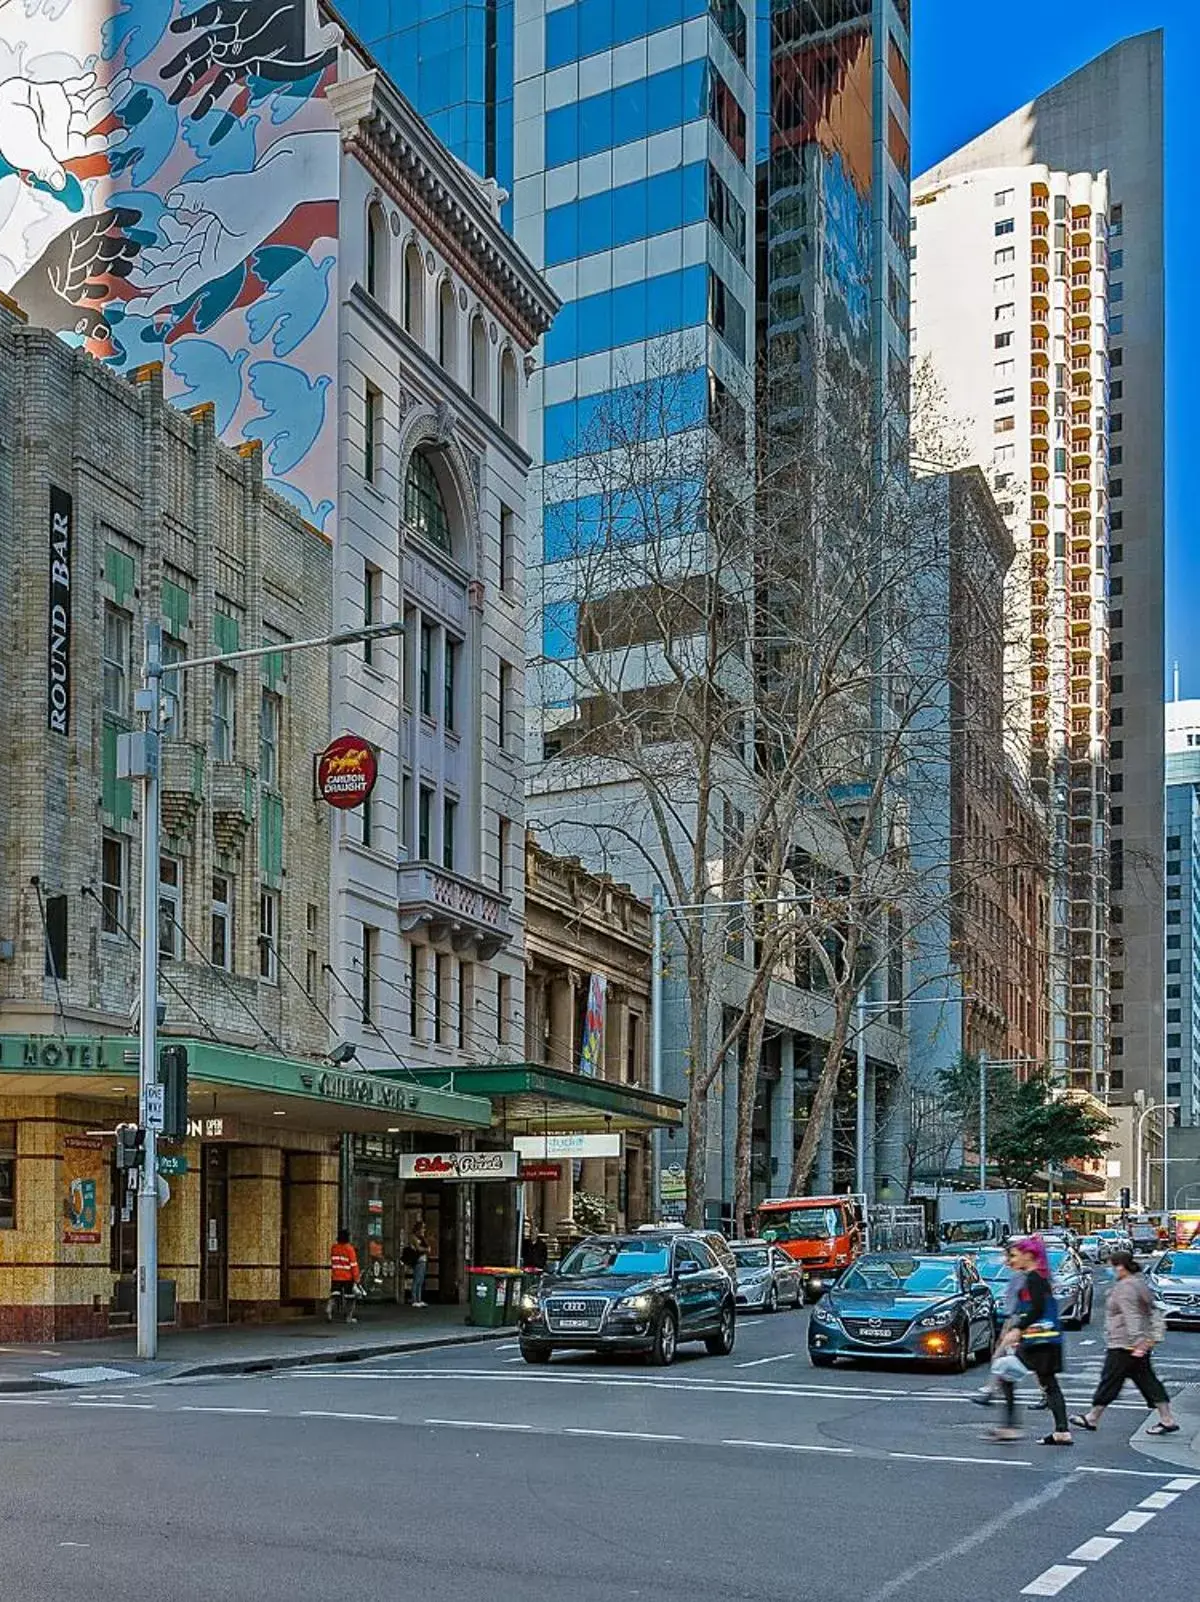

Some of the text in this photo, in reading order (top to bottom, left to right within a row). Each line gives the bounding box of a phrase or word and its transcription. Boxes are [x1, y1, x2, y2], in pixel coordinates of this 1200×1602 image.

[51, 511, 70, 735] ROUND BAR
[324, 782, 367, 793] DRAUGHT
[326, 774, 365, 784] CARLTON
[23, 1043, 108, 1068] HOTEL
